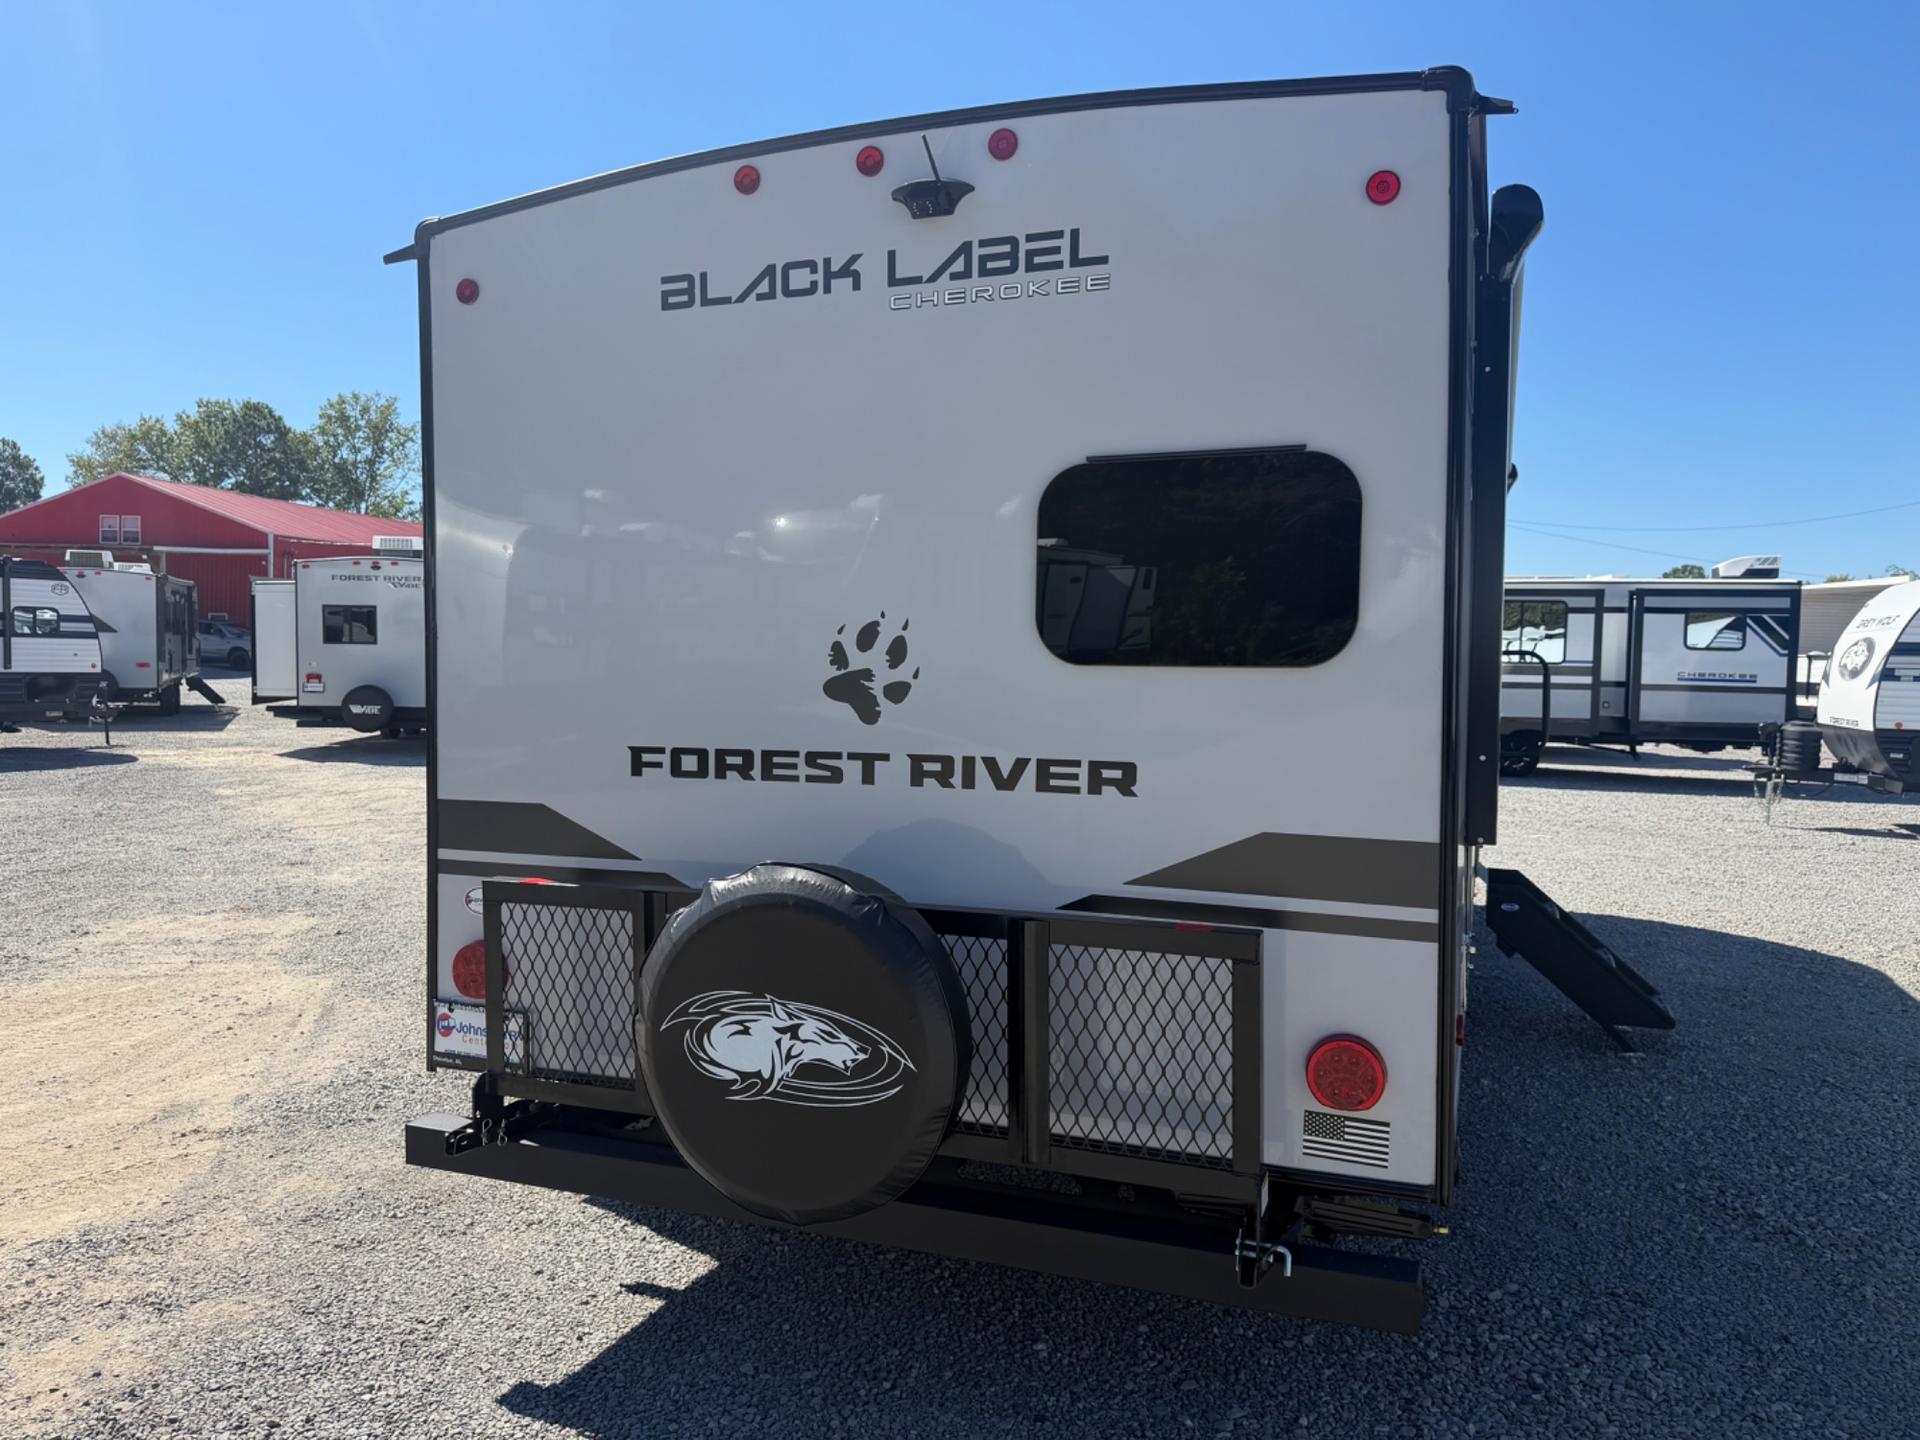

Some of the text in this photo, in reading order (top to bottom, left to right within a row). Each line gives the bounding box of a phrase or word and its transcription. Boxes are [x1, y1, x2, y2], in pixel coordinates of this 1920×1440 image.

[660, 227, 1110, 311] BLACK LABEL
[888, 273, 1111, 311] CHEROKEE
[331, 574, 422, 583] FOREST RIVER
[1677, 671, 1758, 680] CHEROKEE
[627, 746, 1138, 798] FOREST RIVER
